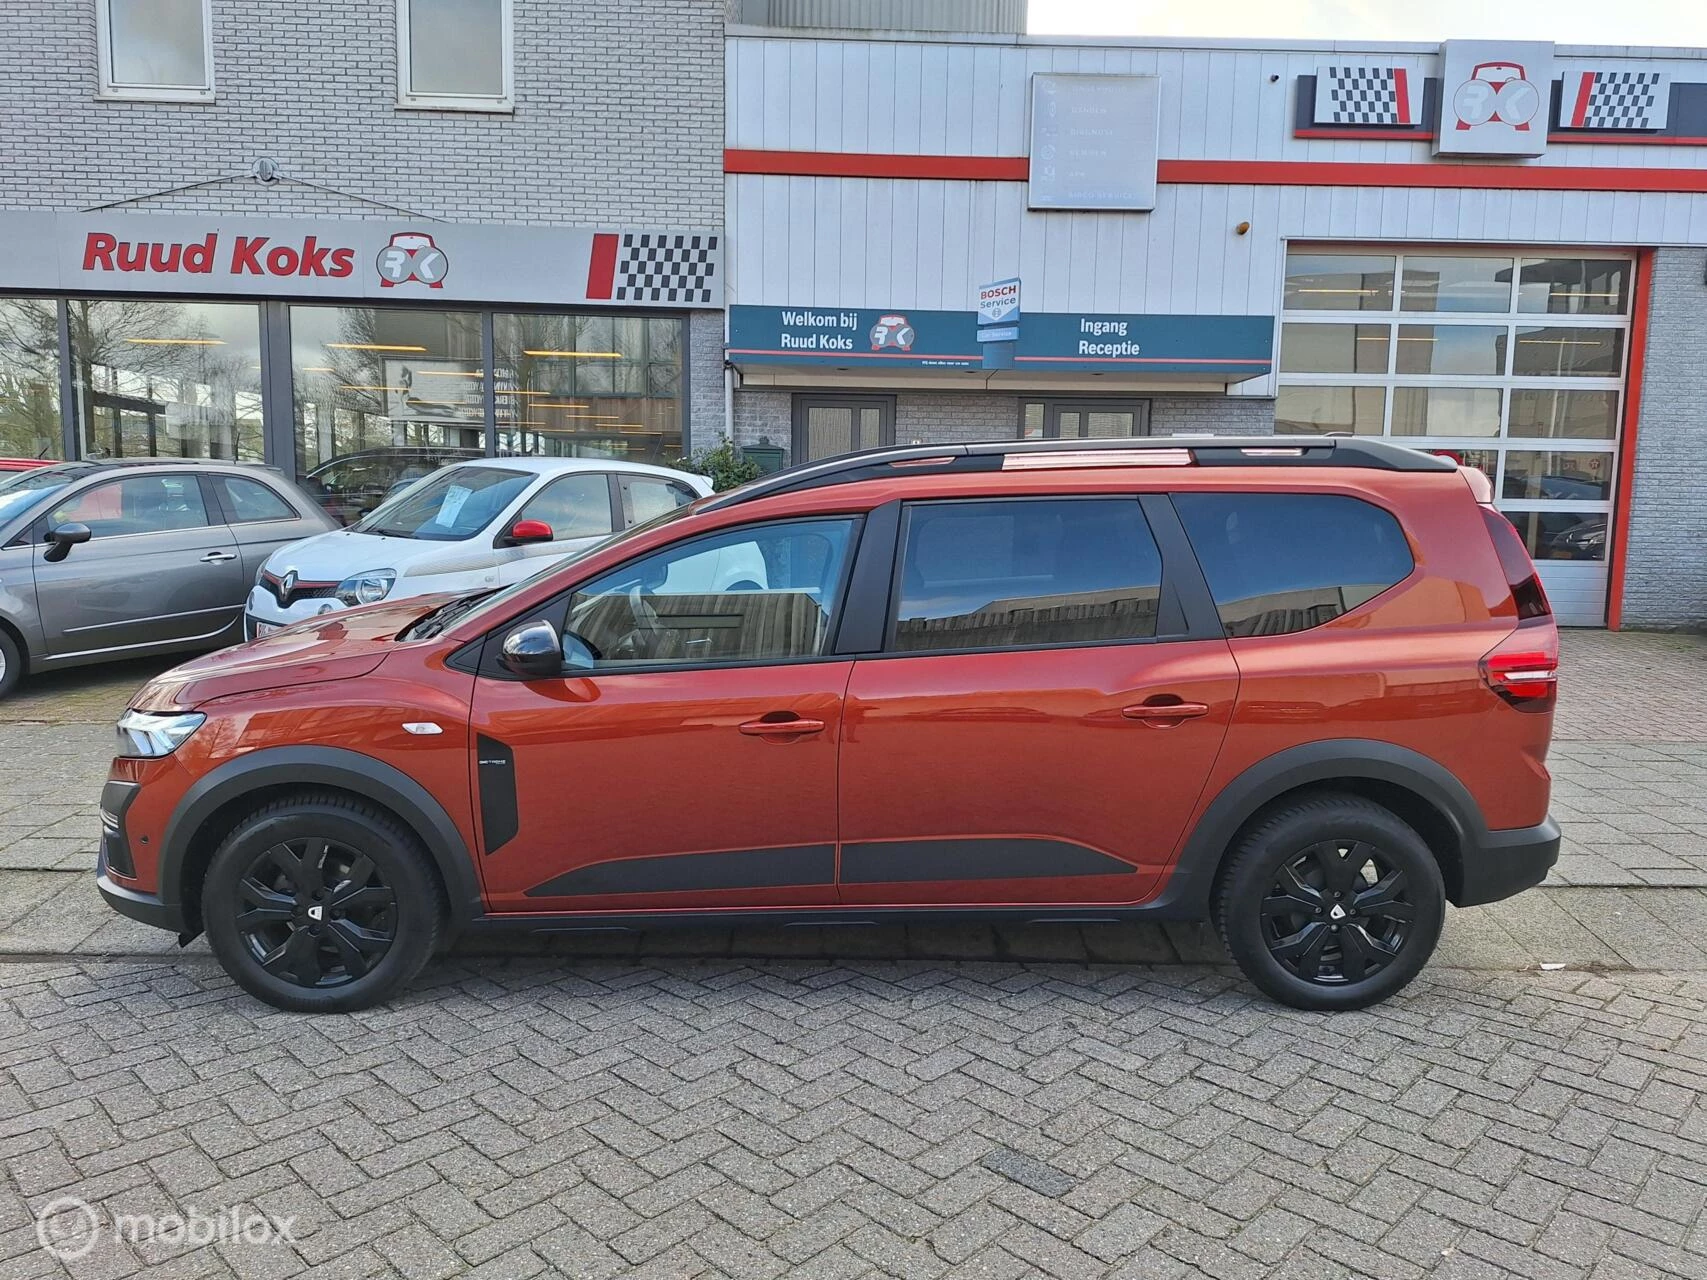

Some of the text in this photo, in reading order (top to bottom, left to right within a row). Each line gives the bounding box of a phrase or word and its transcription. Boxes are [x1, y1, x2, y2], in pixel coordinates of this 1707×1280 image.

[83, 233, 354, 278] Ruud Koks
[980, 285, 1017, 300] BOSCH
[980, 297, 1016, 309] Service
[781, 311, 858, 331] Welkom bij
[1080, 318, 1128, 336] Ingang
[781, 333, 853, 350] Ruud Koks
[1078, 340, 1140, 358] Receptie
